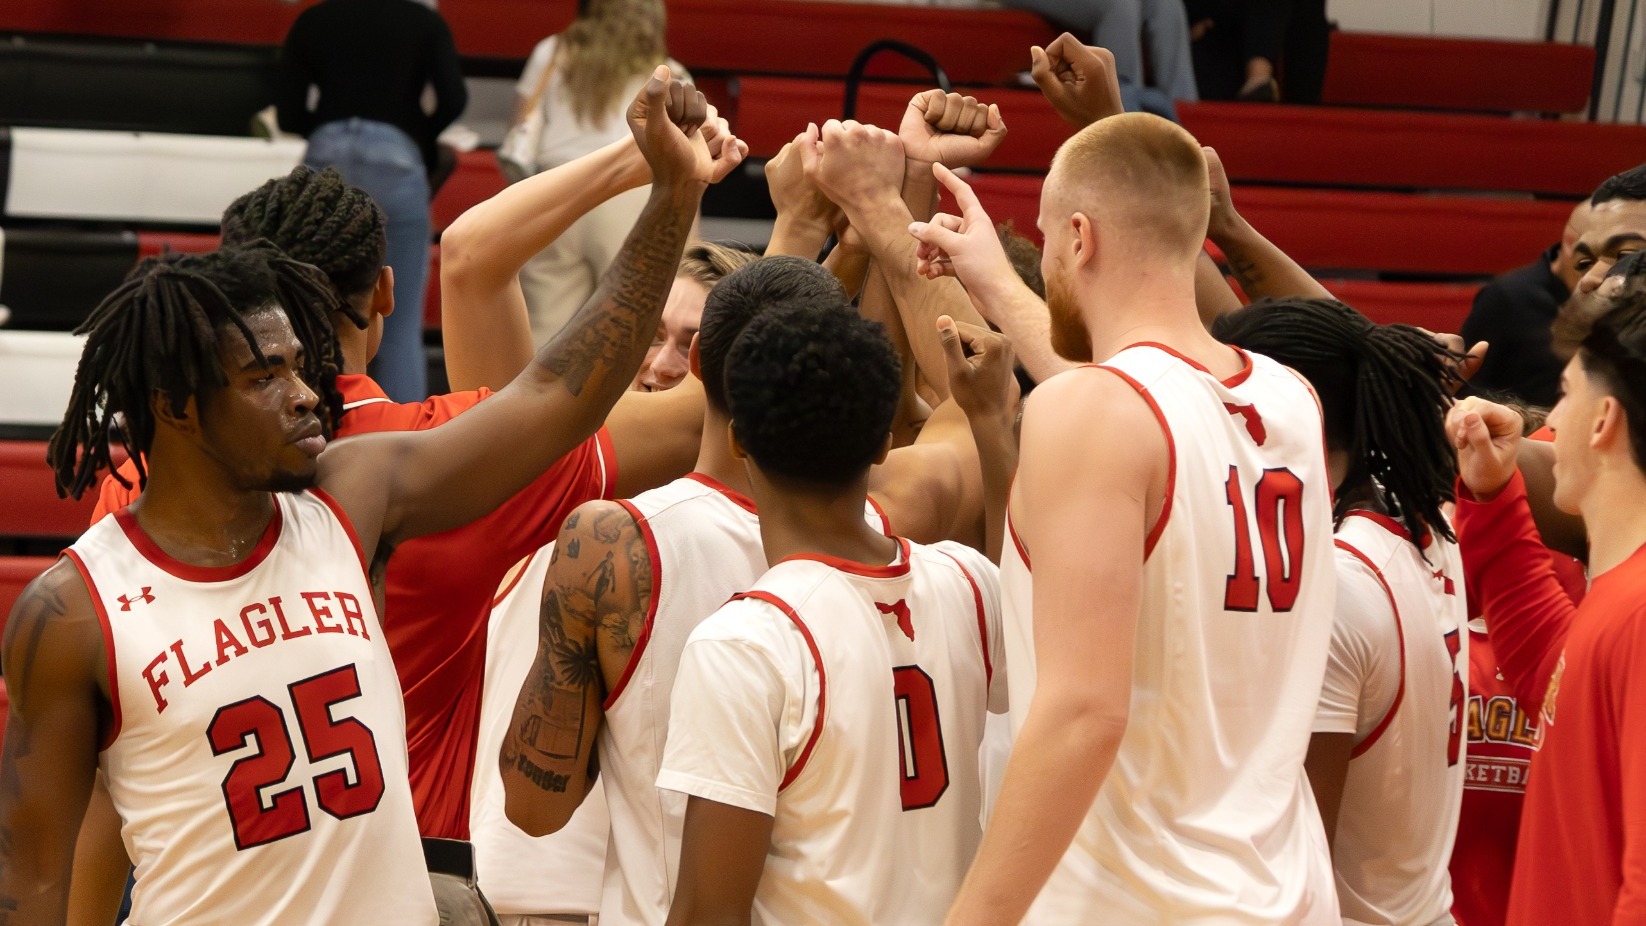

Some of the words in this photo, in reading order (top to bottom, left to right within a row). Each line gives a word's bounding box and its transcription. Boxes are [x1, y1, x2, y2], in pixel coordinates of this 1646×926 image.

[1224, 464, 1305, 613] 10
[141, 590, 371, 715] FLAGLER
[206, 663, 386, 852] 25
[892, 664, 950, 812] 0
